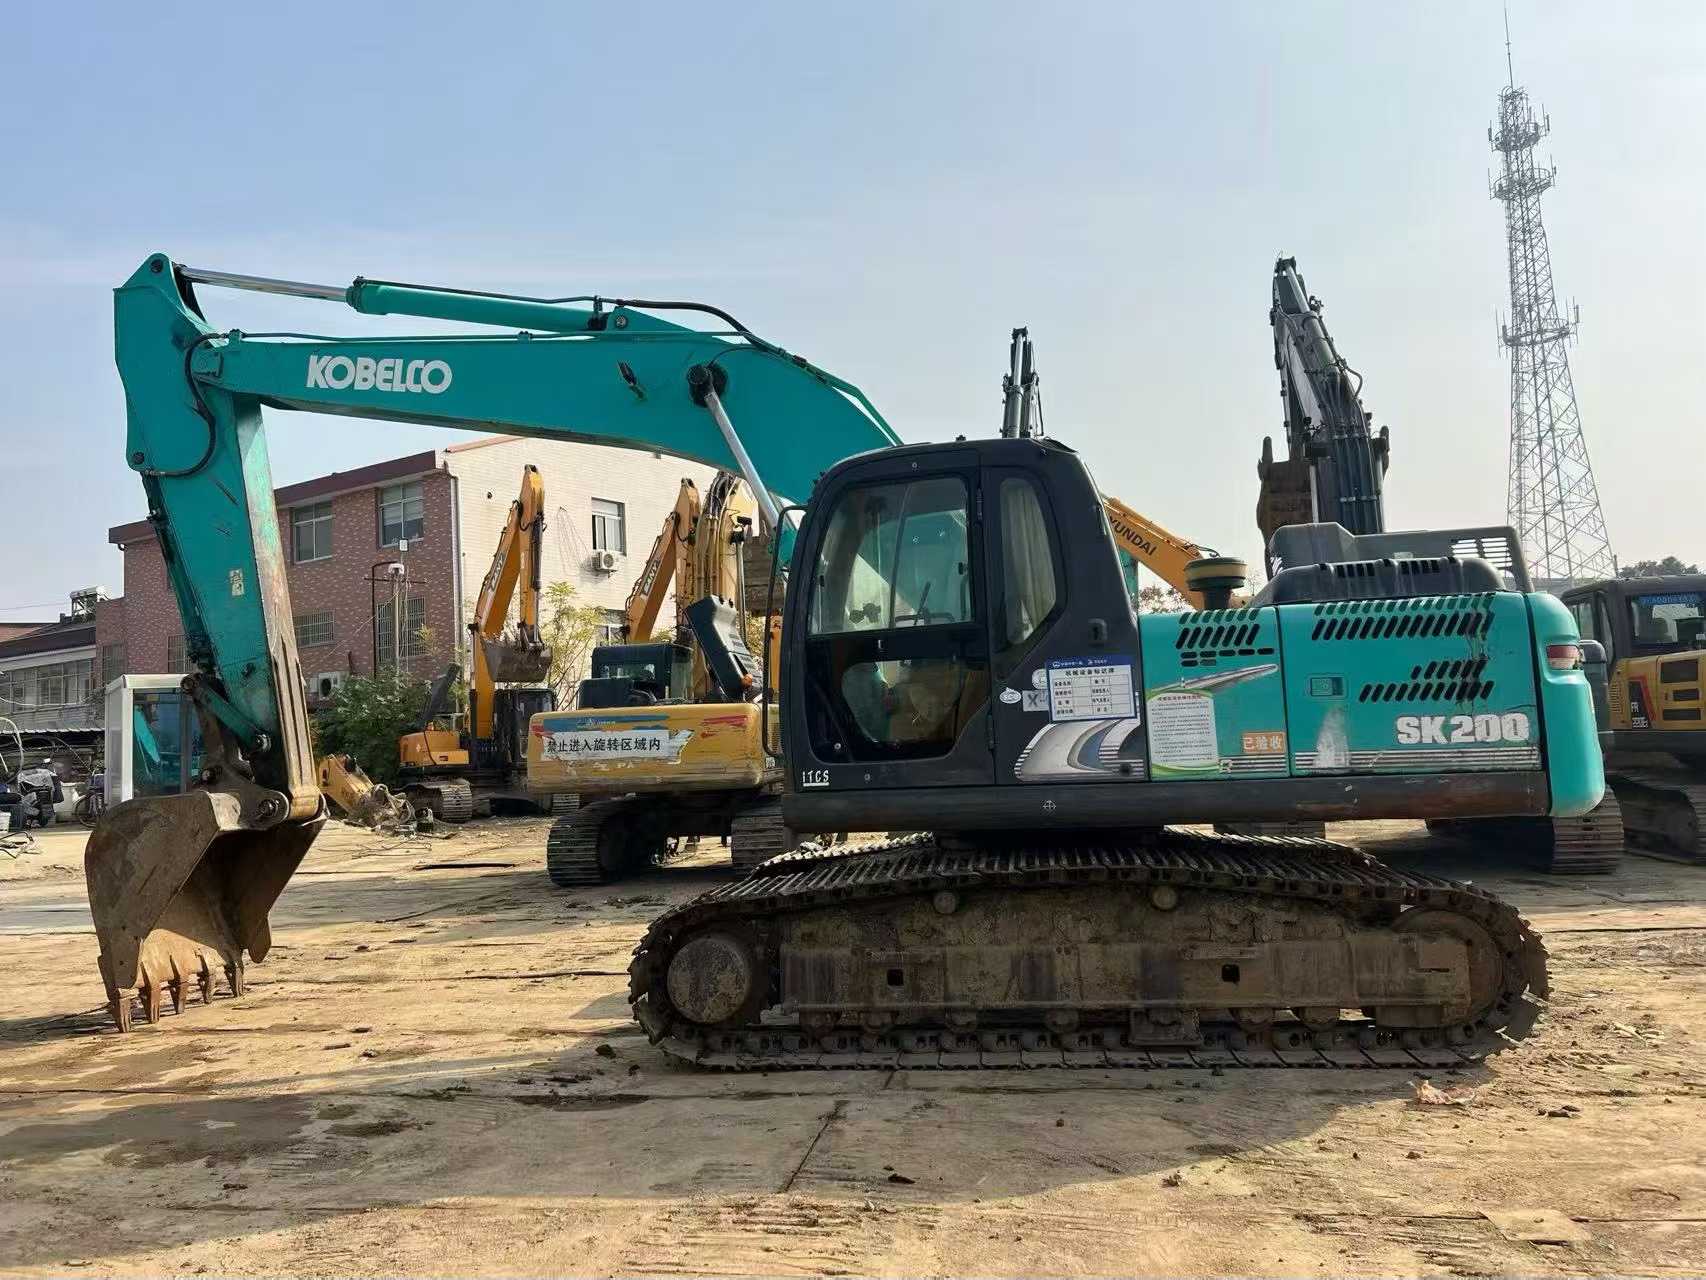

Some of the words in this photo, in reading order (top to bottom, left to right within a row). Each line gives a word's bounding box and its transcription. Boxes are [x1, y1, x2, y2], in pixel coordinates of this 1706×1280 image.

[306, 354, 453, 394] KOBELCO
[1109, 515, 1157, 556] YUNDAI
[1242, 734, 1283, 751] 已验收
[1396, 713, 1530, 744] SK200
[546, 737, 661, 753] 禁止进入旋转区域内
